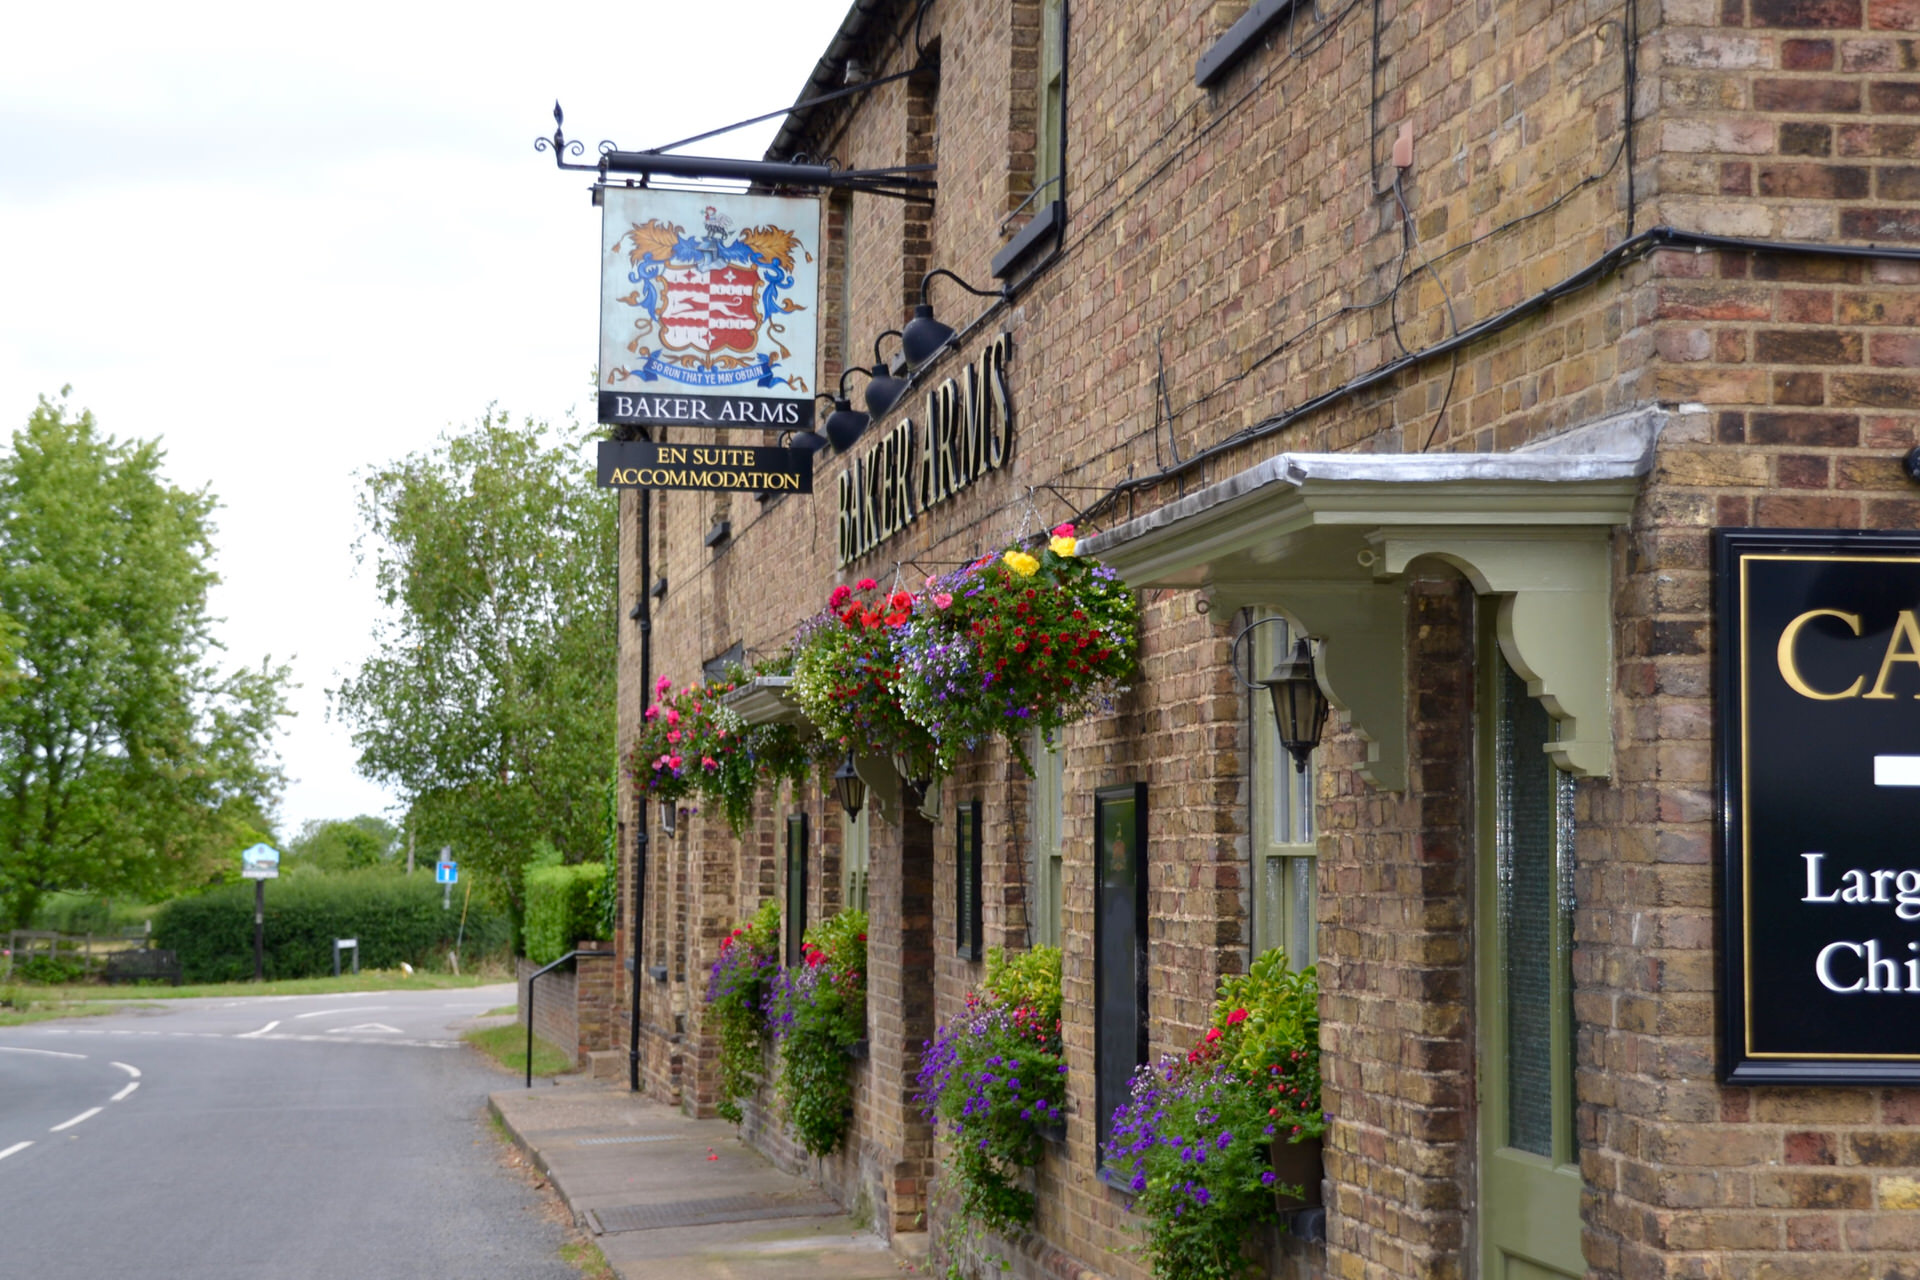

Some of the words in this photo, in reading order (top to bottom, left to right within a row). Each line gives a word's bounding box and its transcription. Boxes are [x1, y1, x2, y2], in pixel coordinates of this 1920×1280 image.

[651, 361, 663, 371] SO
[663, 366, 681, 378] RUN
[681, 371, 704, 384] THAT
[704, 374, 717, 385] YE
[717, 373, 735, 384] MAY
[735, 367, 764, 381] OBTAIN
[615, 396, 713, 421] BAKER
[717, 400, 800, 424] ARMS
[656, 447, 688, 465] EN
[692, 449, 756, 467] SUITE
[837, 417, 917, 571] BAKER
[919, 333, 1012, 513] ARMS
[609, 467, 801, 490] ACCOMMODATION
[1800, 852, 1920, 920] Larg
